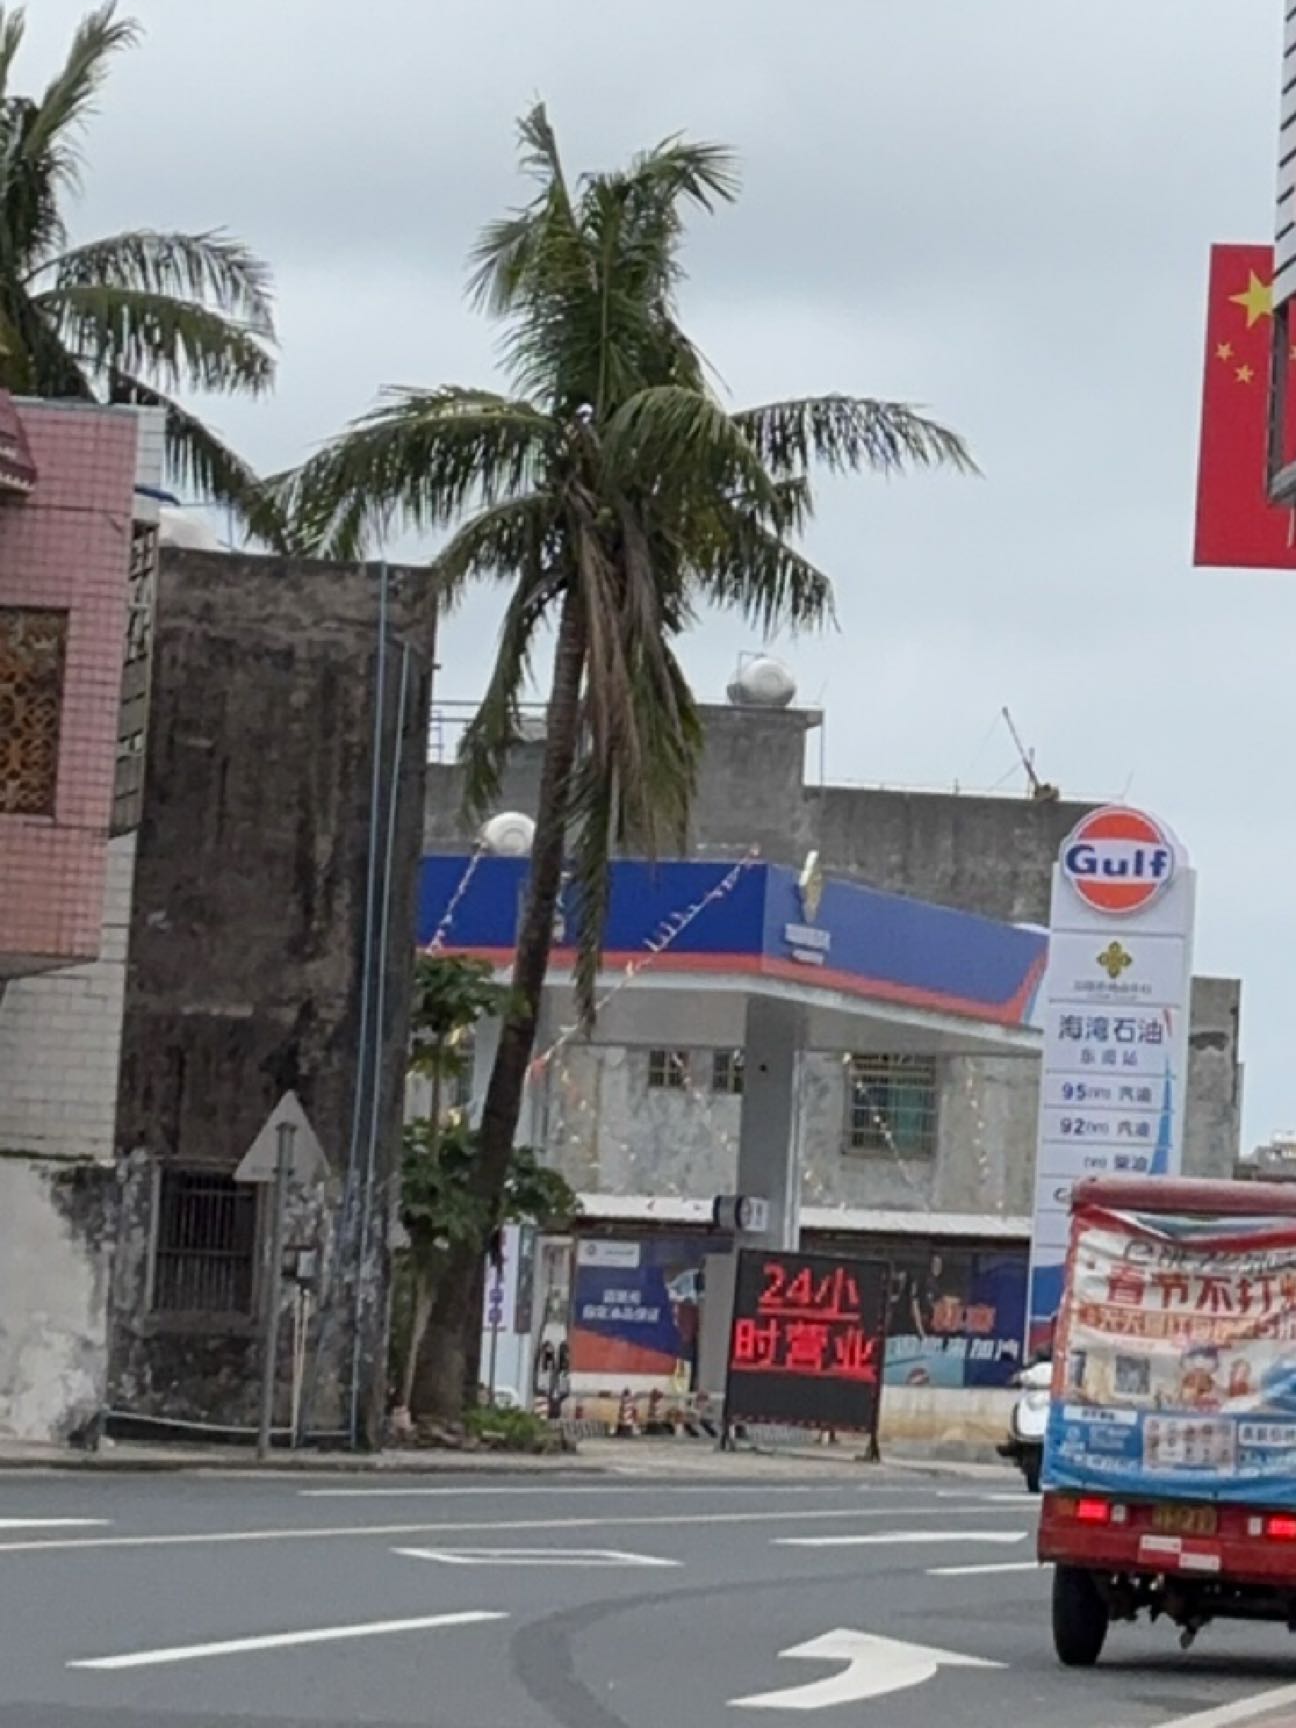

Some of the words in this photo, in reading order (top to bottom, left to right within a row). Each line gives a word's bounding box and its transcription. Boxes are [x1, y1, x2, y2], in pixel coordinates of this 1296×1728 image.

[1065, 843, 1168, 879] Gulf
[1058, 1014, 1164, 1045] 海湾石油
[758, 1261, 860, 1314] 24小
[734, 1318, 877, 1381] 时营业
